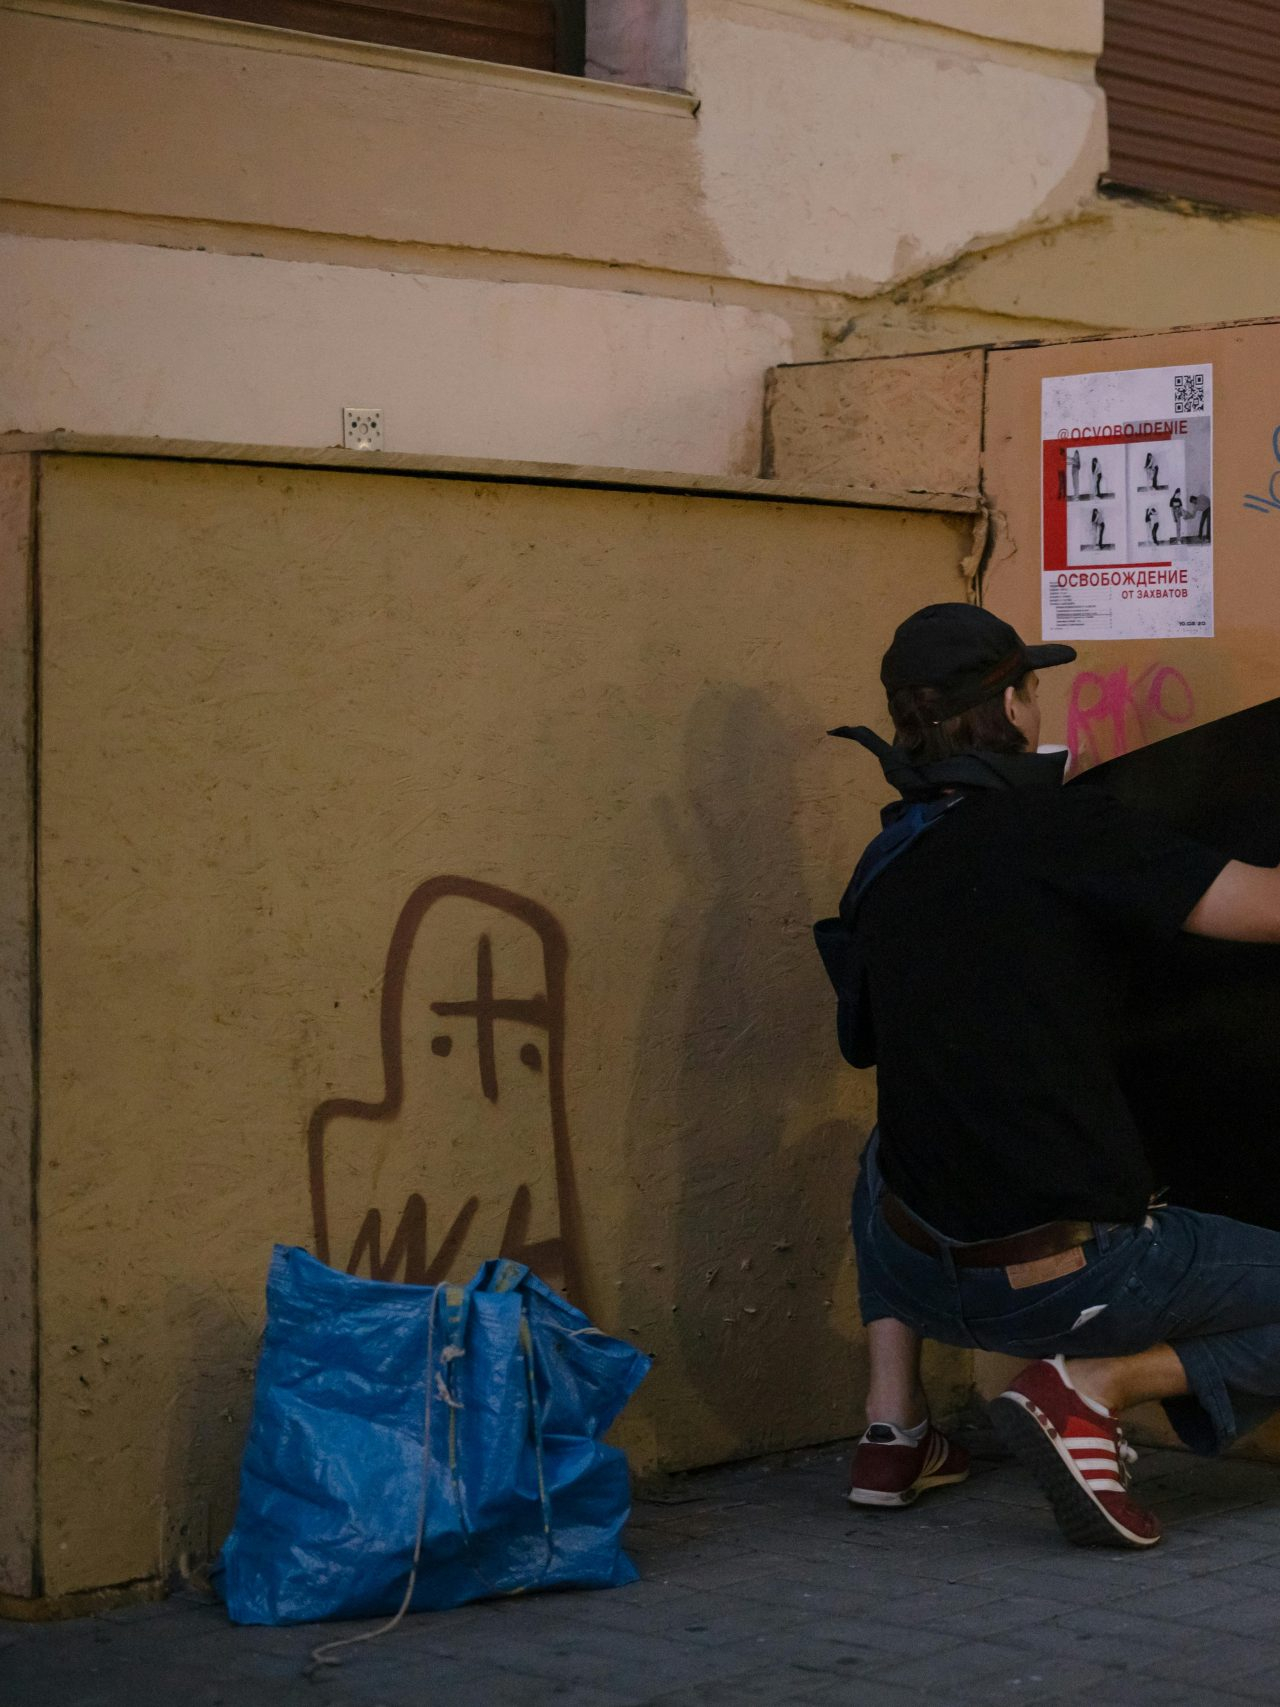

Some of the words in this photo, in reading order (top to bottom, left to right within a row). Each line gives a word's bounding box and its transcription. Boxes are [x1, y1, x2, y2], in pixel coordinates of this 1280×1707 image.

[1057, 569, 1188, 588] ОСВОБОЖДЕНИЕ
[1121, 589, 1134, 600] ОТ
[1136, 588, 1188, 600] ЗАХВАТОВ
